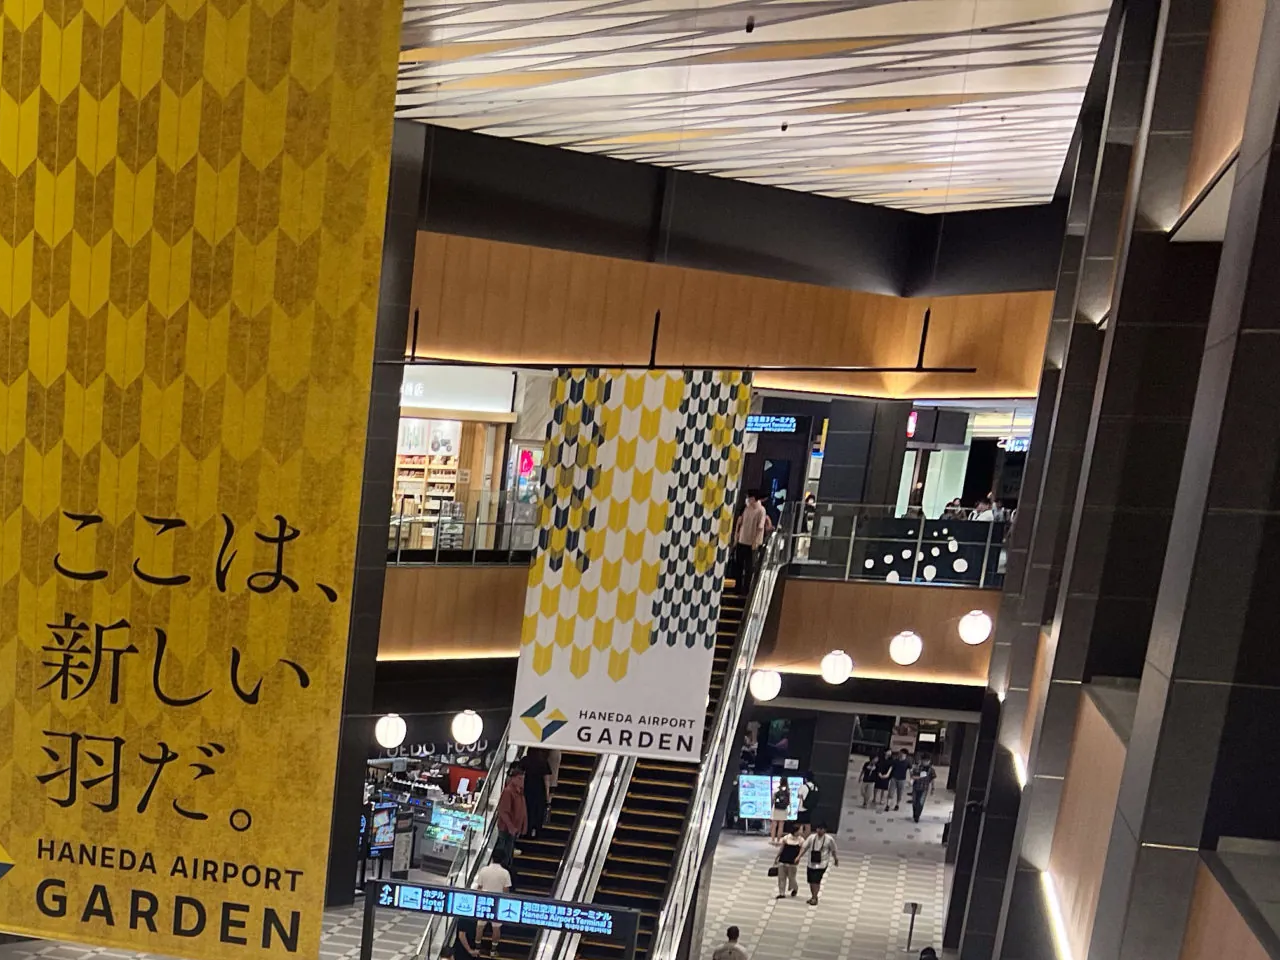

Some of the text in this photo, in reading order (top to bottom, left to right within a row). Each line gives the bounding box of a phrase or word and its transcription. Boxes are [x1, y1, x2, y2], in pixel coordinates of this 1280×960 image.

[54, 511, 338, 602] ここは、
[37, 612, 310, 706] 新しい
[578, 710, 696, 729] HANEDA AIRPORT
[576, 726, 694, 752] GARDEN
[36, 730, 252, 832] 羽だ。
[37, 838, 304, 892] HANEDA AIRPORT
[379, 893, 393, 905] 2F
[422, 898, 445, 907] Hotel
[423, 889, 445, 899] ホテル
[36, 878, 301, 953] GARDEN
[522, 909, 549, 920] Haneda
[549, 914, 575, 924] Airport
[576, 917, 607, 928] Terminal
